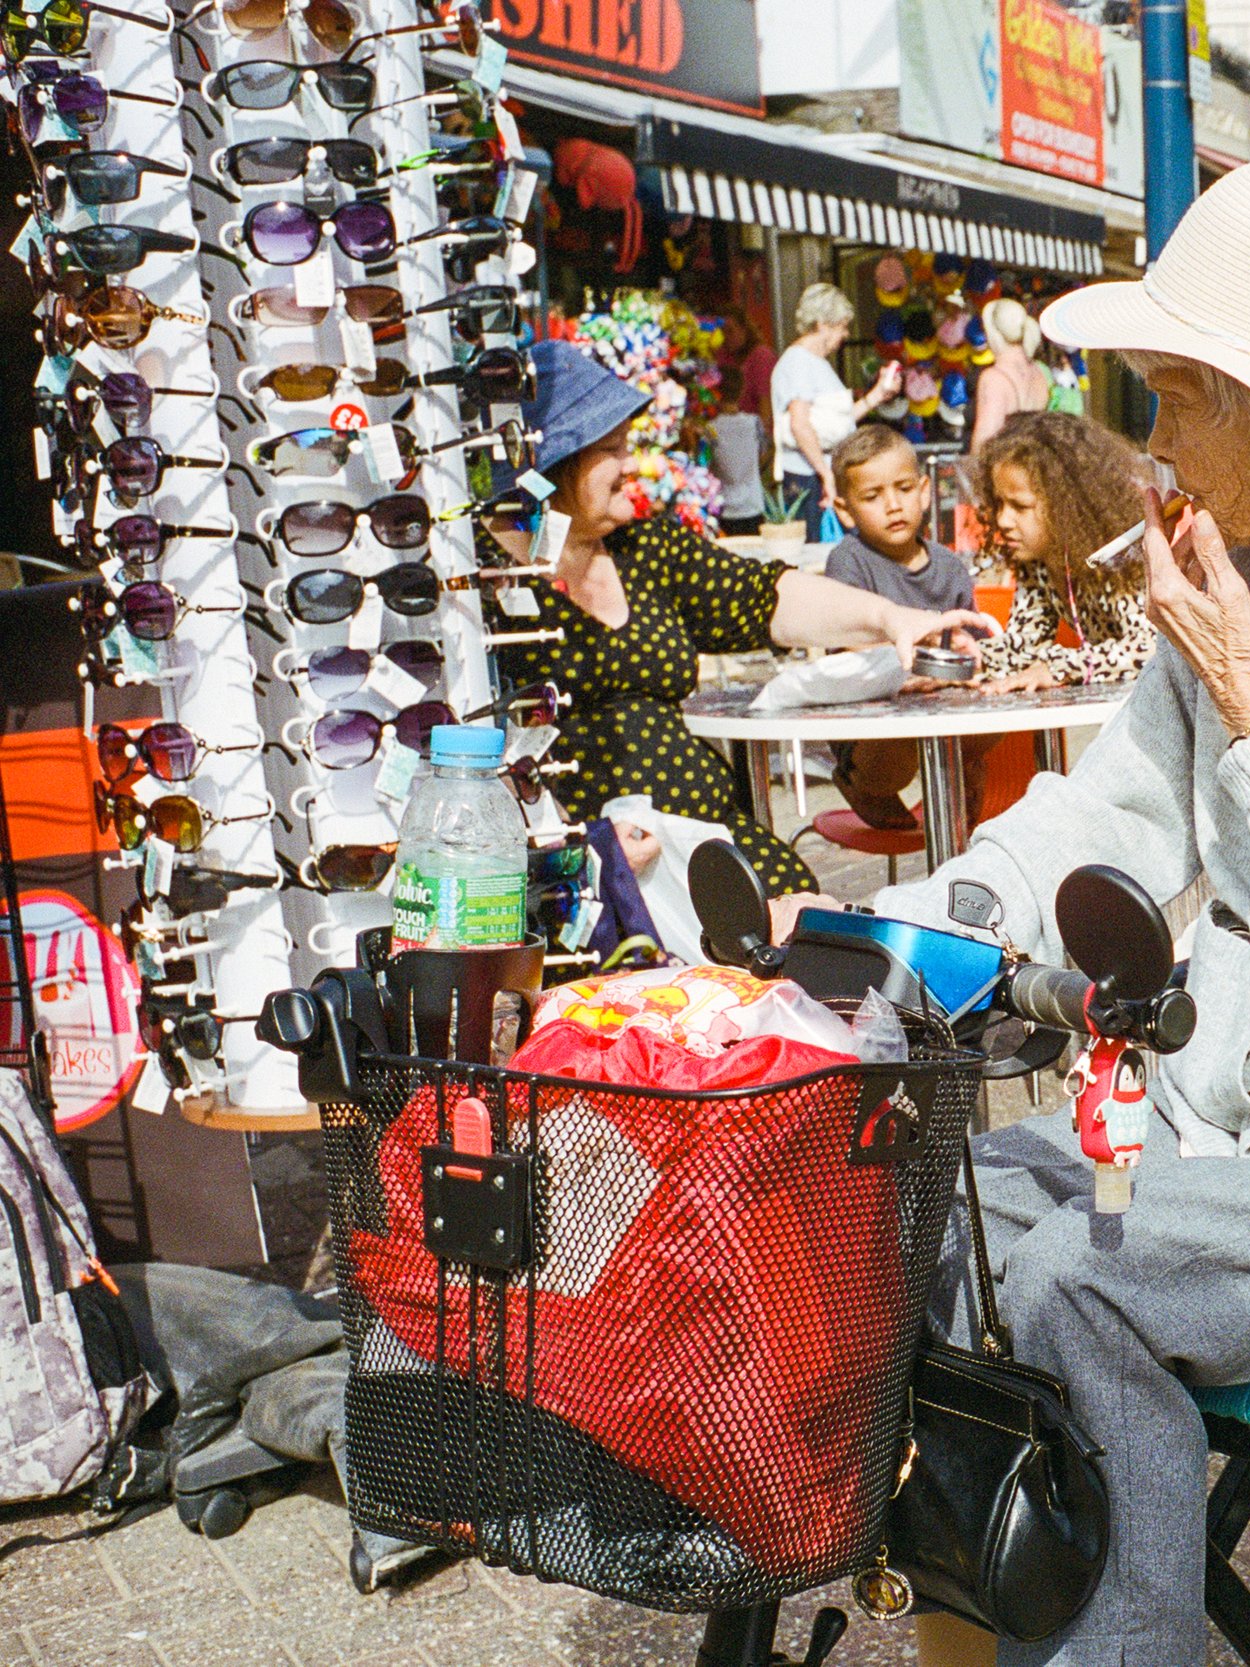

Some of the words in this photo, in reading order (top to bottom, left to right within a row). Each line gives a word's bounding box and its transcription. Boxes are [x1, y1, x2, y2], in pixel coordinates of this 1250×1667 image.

[393, 907, 426, 928] OUCH
[396, 923, 428, 942] FRUIT
[51, 1040, 112, 1077] akes
